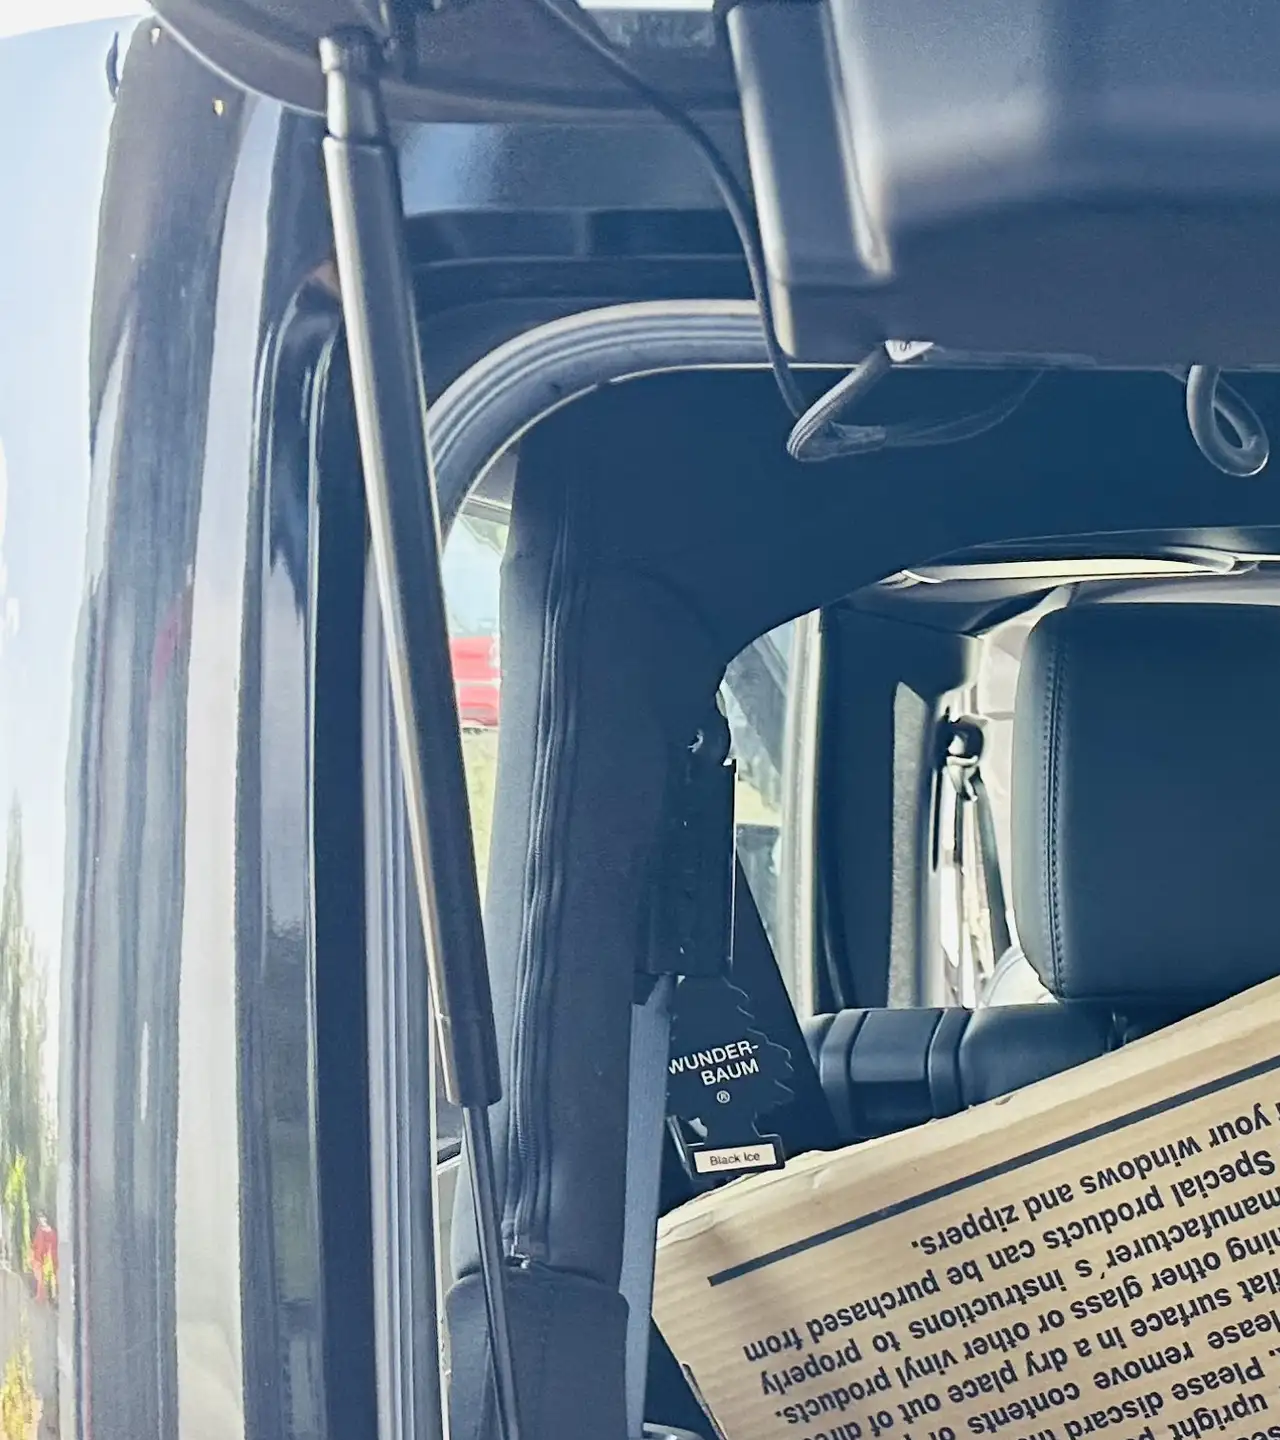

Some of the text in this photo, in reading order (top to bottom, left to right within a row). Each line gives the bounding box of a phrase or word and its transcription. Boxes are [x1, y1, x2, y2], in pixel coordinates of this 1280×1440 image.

[668, 1040, 759, 1075] WUNDER-
[701, 1058, 760, 1086] BAUM
[1206, 1100, 1273, 1149] your
[709, 1151, 761, 1166] Black Ice
[1077, 1134, 1204, 1195] windows
[1168, 1148, 1276, 1209] Special
[1020, 1181, 1075, 1223] and
[1040, 1182, 1166, 1250] products
[909, 1202, 1021, 1256] zippers.
[944, 1257, 985, 1286] be
[984, 1237, 1036, 1271] can
[1149, 1250, 1222, 1293] other
[804, 1267, 942, 1345] purchased
[906, 1267, 1068, 1340] instructions
[1068, 1273, 1144, 1321] glass
[1128, 1286, 1233, 1338] surface
[870, 1329, 902, 1354] to
[961, 1320, 1031, 1362] other
[1035, 1307, 1066, 1335] or
[1094, 1324, 1129, 1350] in
[740, 1325, 804, 1363] from
[1023, 1345, 1069, 1378] dry
[1091, 1339, 1196, 1391] remove
[759, 1336, 864, 1396] properly
[893, 1347, 960, 1390] vinyl
[945, 1357, 1020, 1404] place
[1169, 1354, 1267, 1402] Please
[773, 1364, 893, 1425] products.
[895, 1391, 942, 1426] out
[965, 1380, 1081, 1435] contents
[865, 1408, 895, 1439] of
